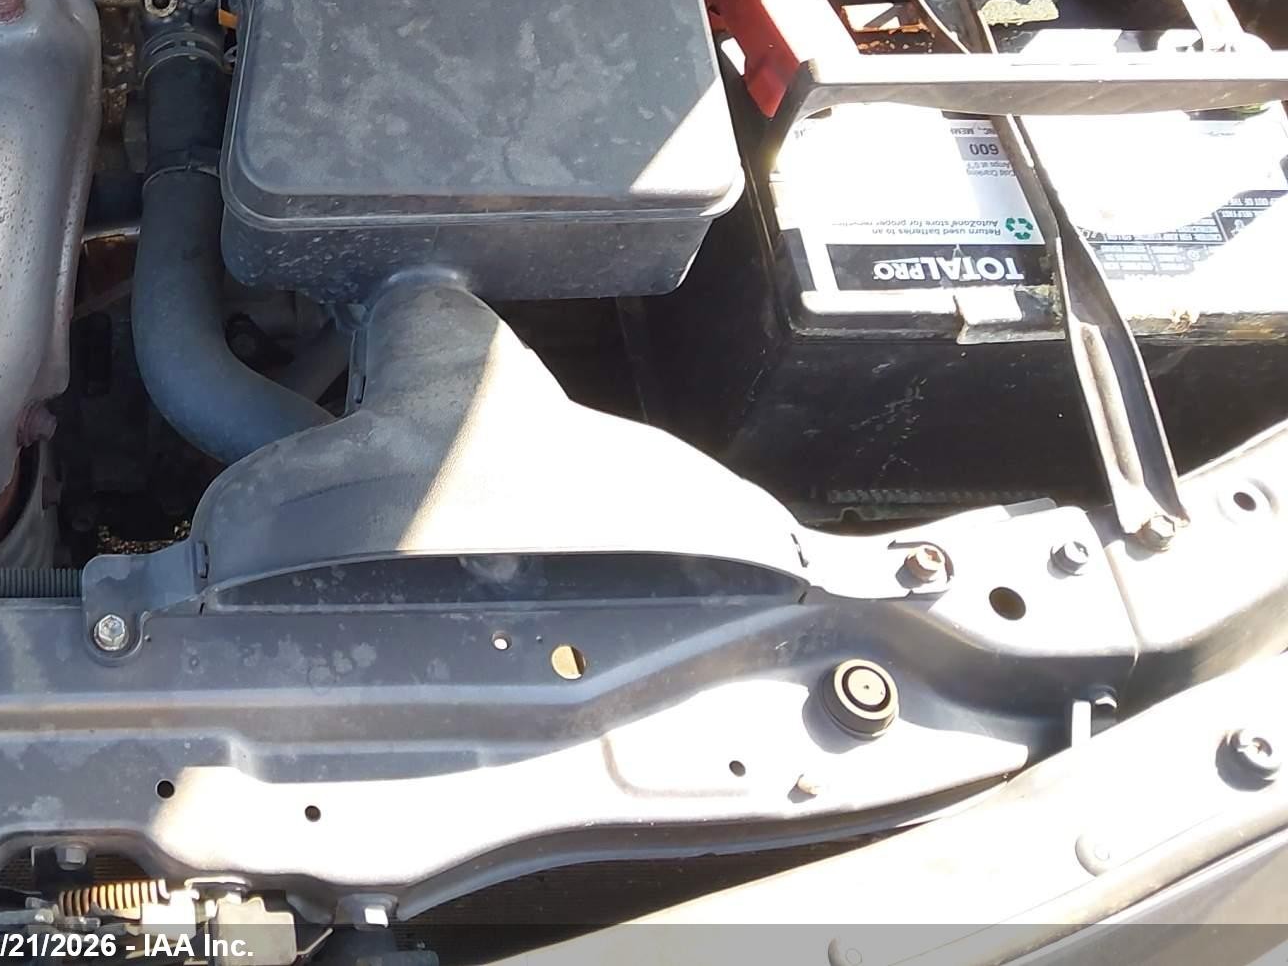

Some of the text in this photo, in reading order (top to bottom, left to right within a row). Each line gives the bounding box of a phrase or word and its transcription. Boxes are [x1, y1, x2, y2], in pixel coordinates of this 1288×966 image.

[969, 143, 1000, 156] 600
[898, 228, 940, 236] batteries
[968, 228, 1001, 236] Return
